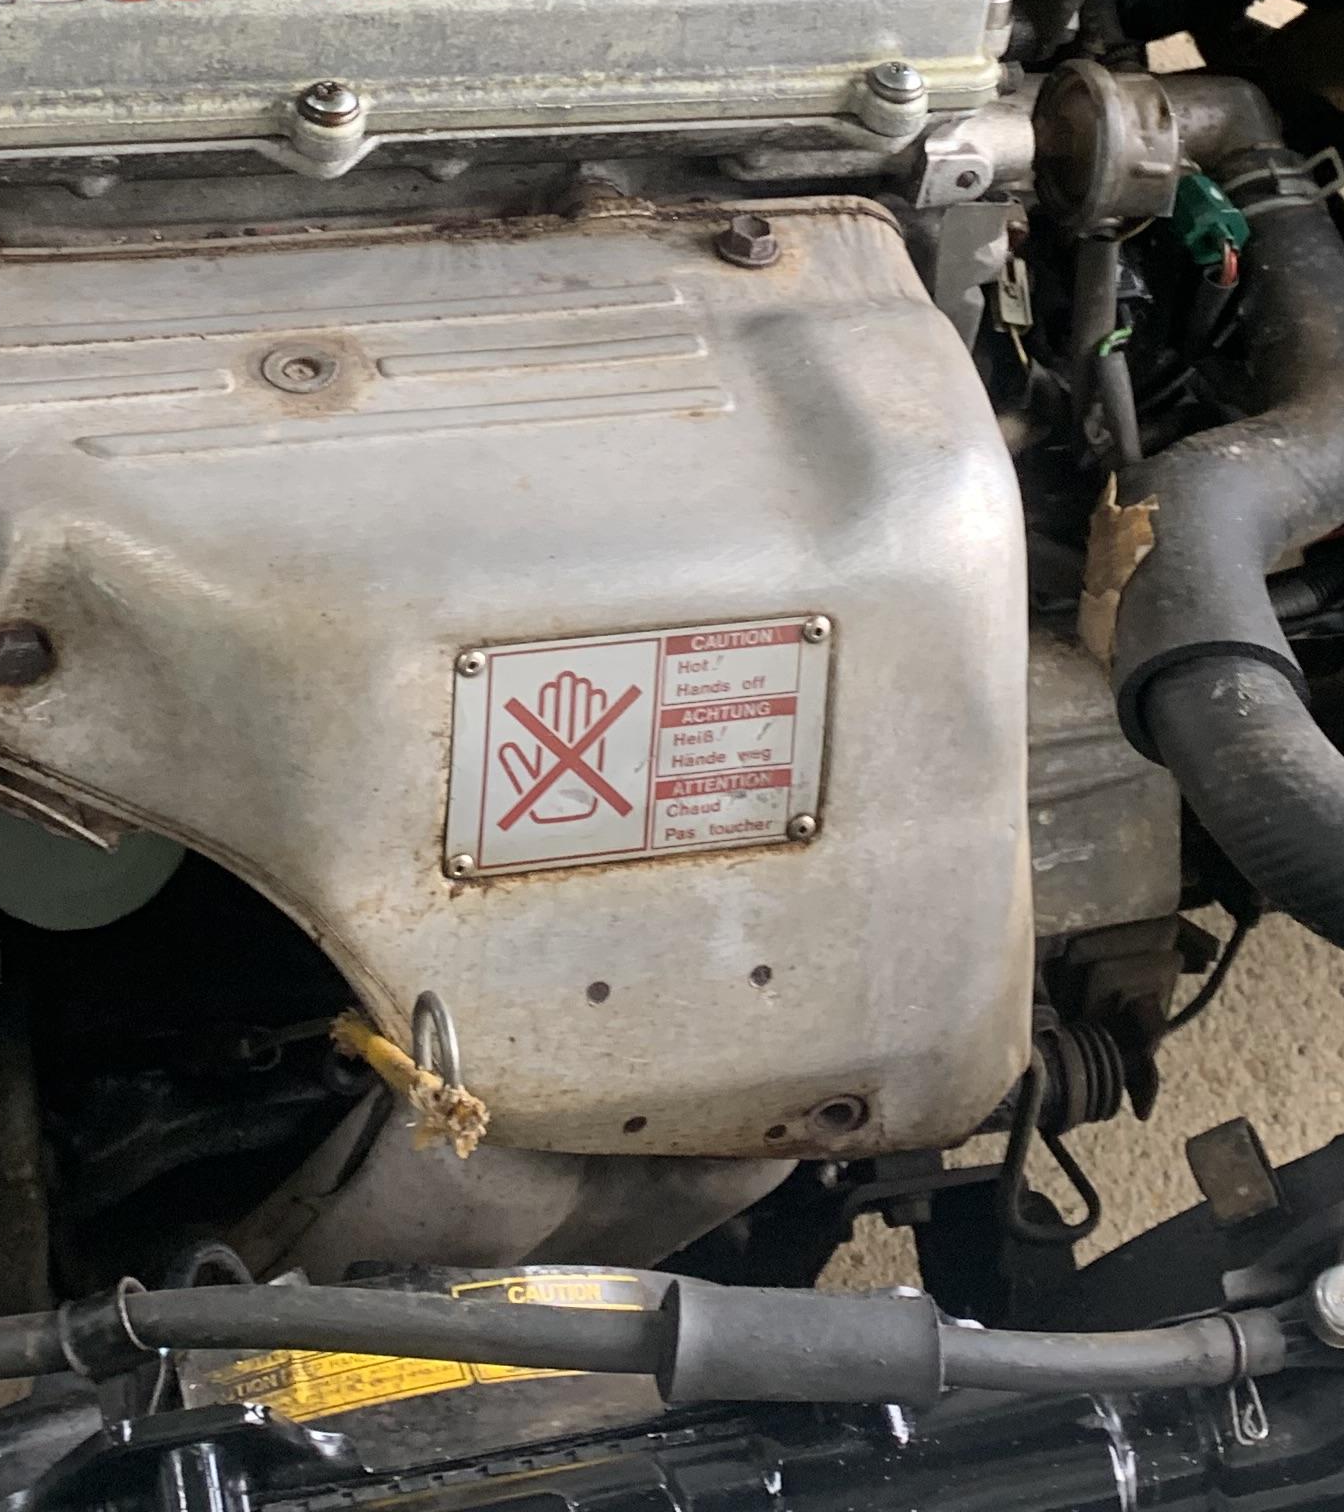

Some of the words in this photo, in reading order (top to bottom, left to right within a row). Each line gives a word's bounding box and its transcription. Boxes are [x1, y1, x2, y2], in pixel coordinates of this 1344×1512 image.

[690, 628, 774, 651] CAUTION
[676, 680, 731, 697] Hands
[741, 675, 767, 690] off
[681, 701, 771, 725] ACHTUNG
[671, 752, 727, 769] Hände
[737, 748, 772, 763] weg
[672, 772, 771, 796] ATTENTION
[666, 799, 721, 818] Chaud
[664, 828, 696, 841] Pas
[709, 818, 775, 836] toucher
[508, 1284, 602, 1304] CAUTION
